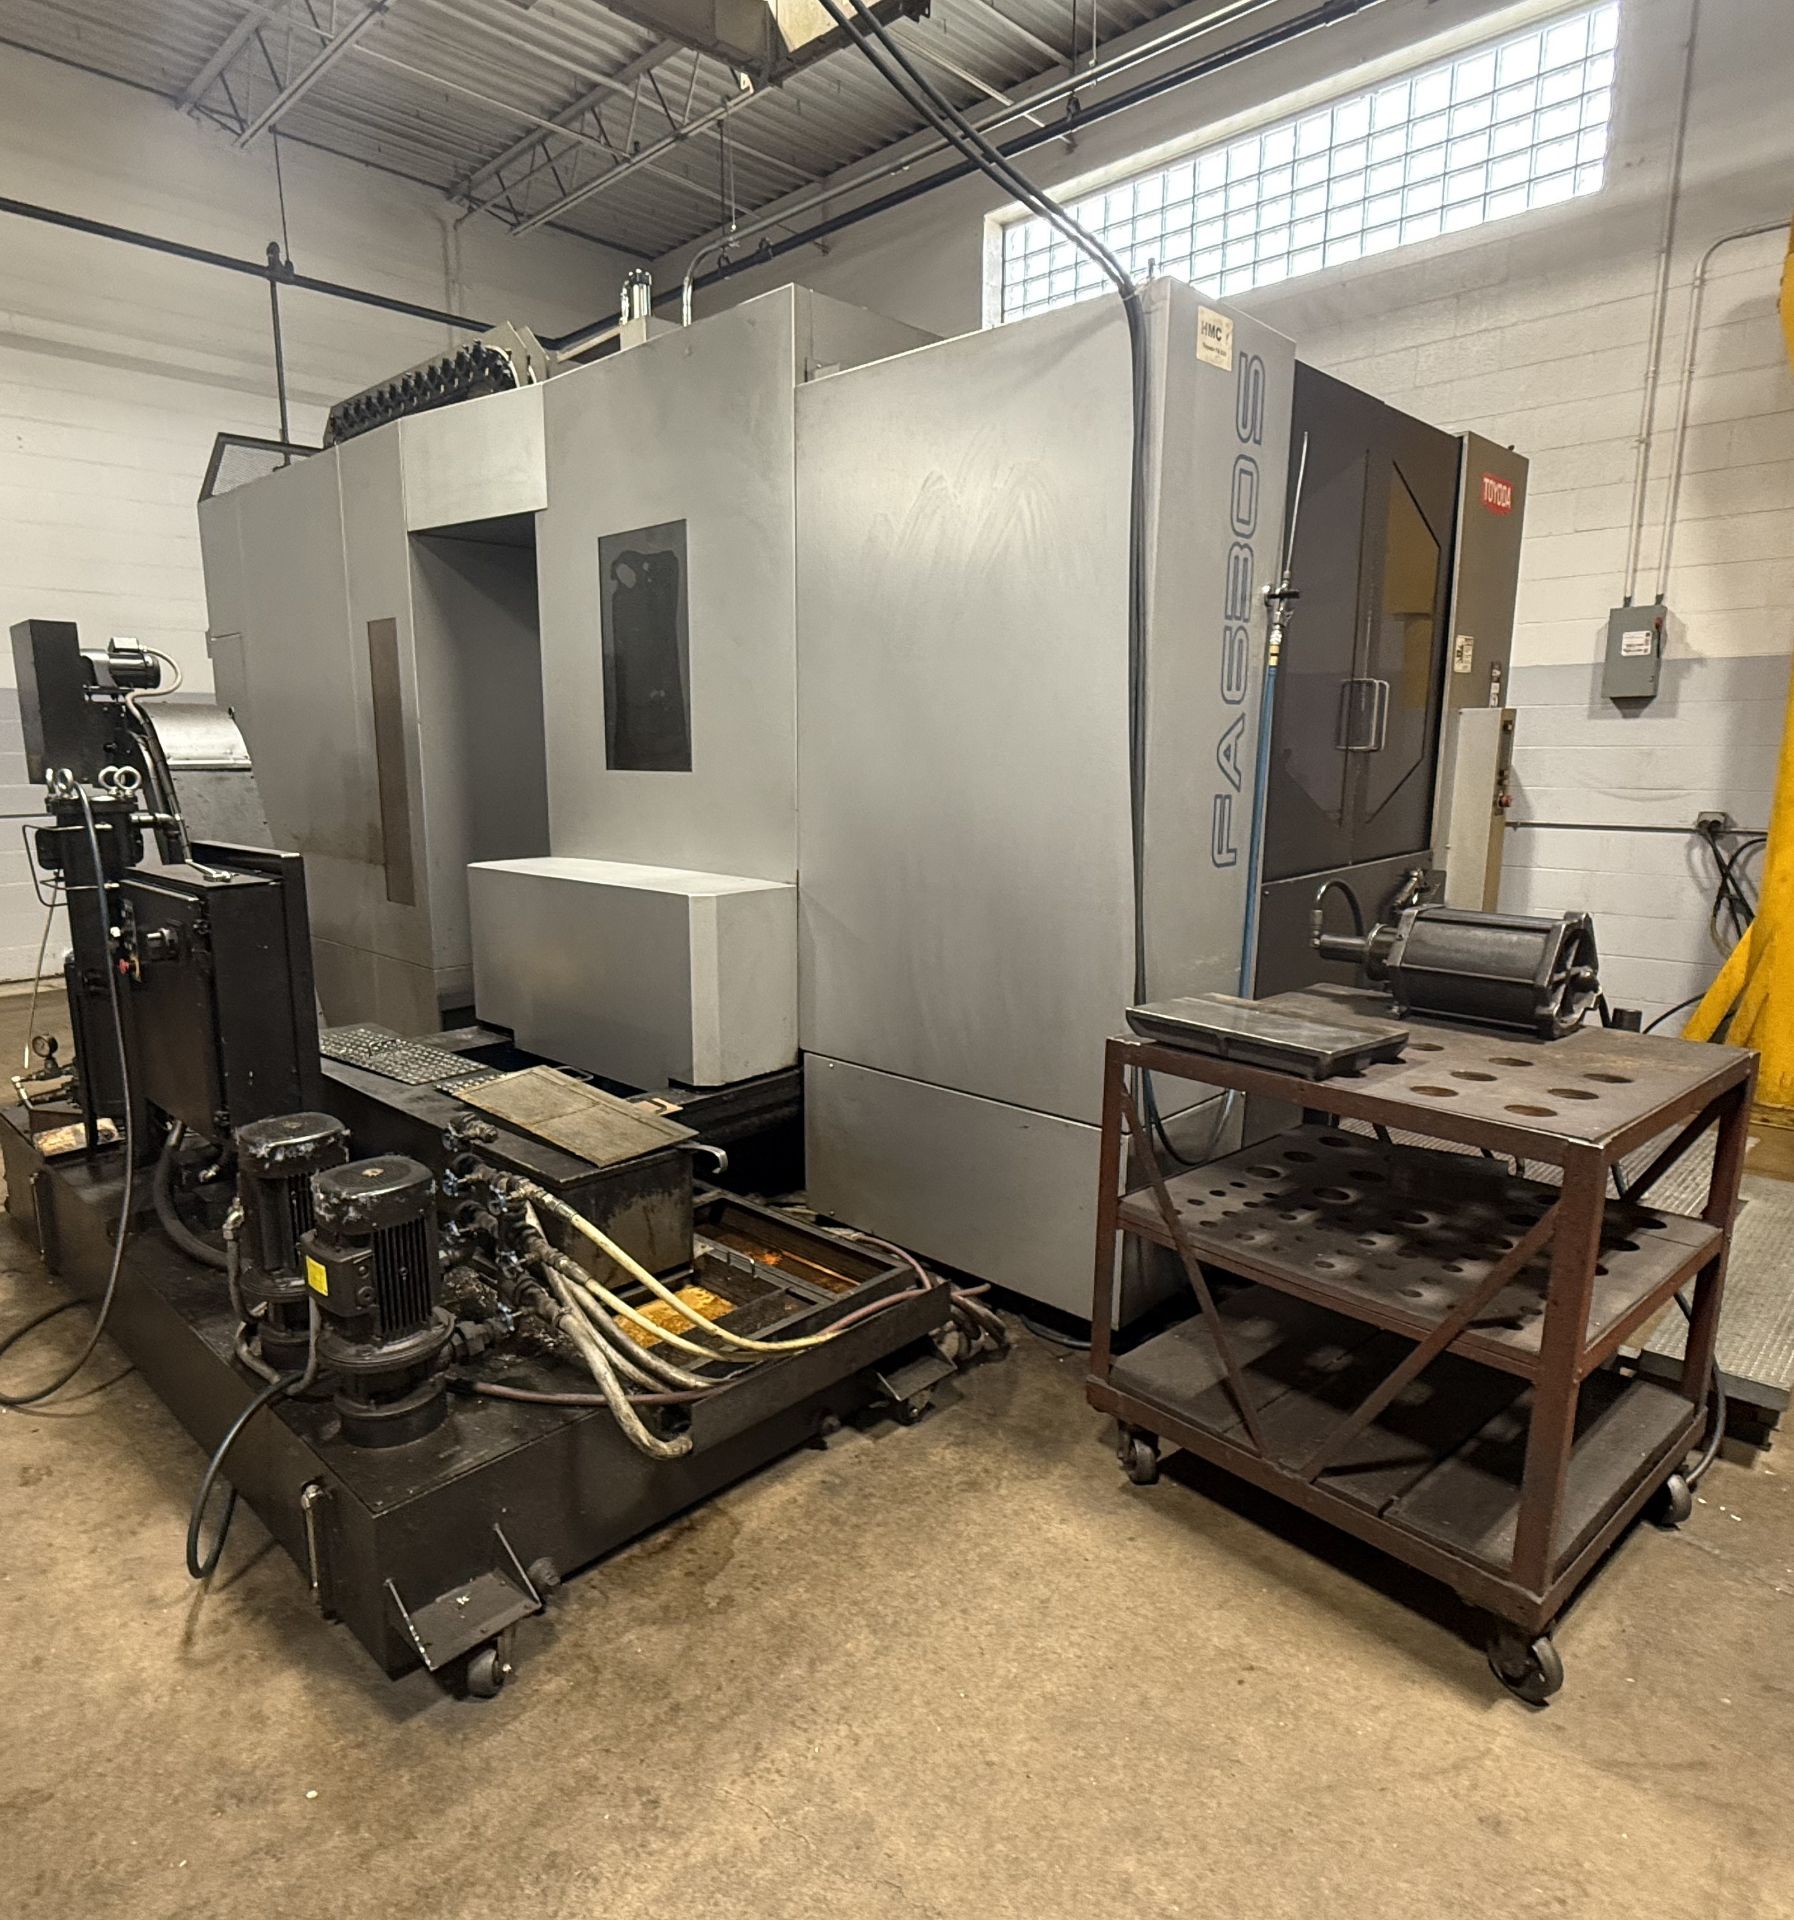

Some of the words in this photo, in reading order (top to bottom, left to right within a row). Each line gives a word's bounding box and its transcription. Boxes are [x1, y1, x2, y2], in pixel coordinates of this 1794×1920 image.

[1201, 321, 1222, 342] HMC
[1483, 477, 1512, 509] TOYODA
[1212, 351, 1265, 868] FA630S
